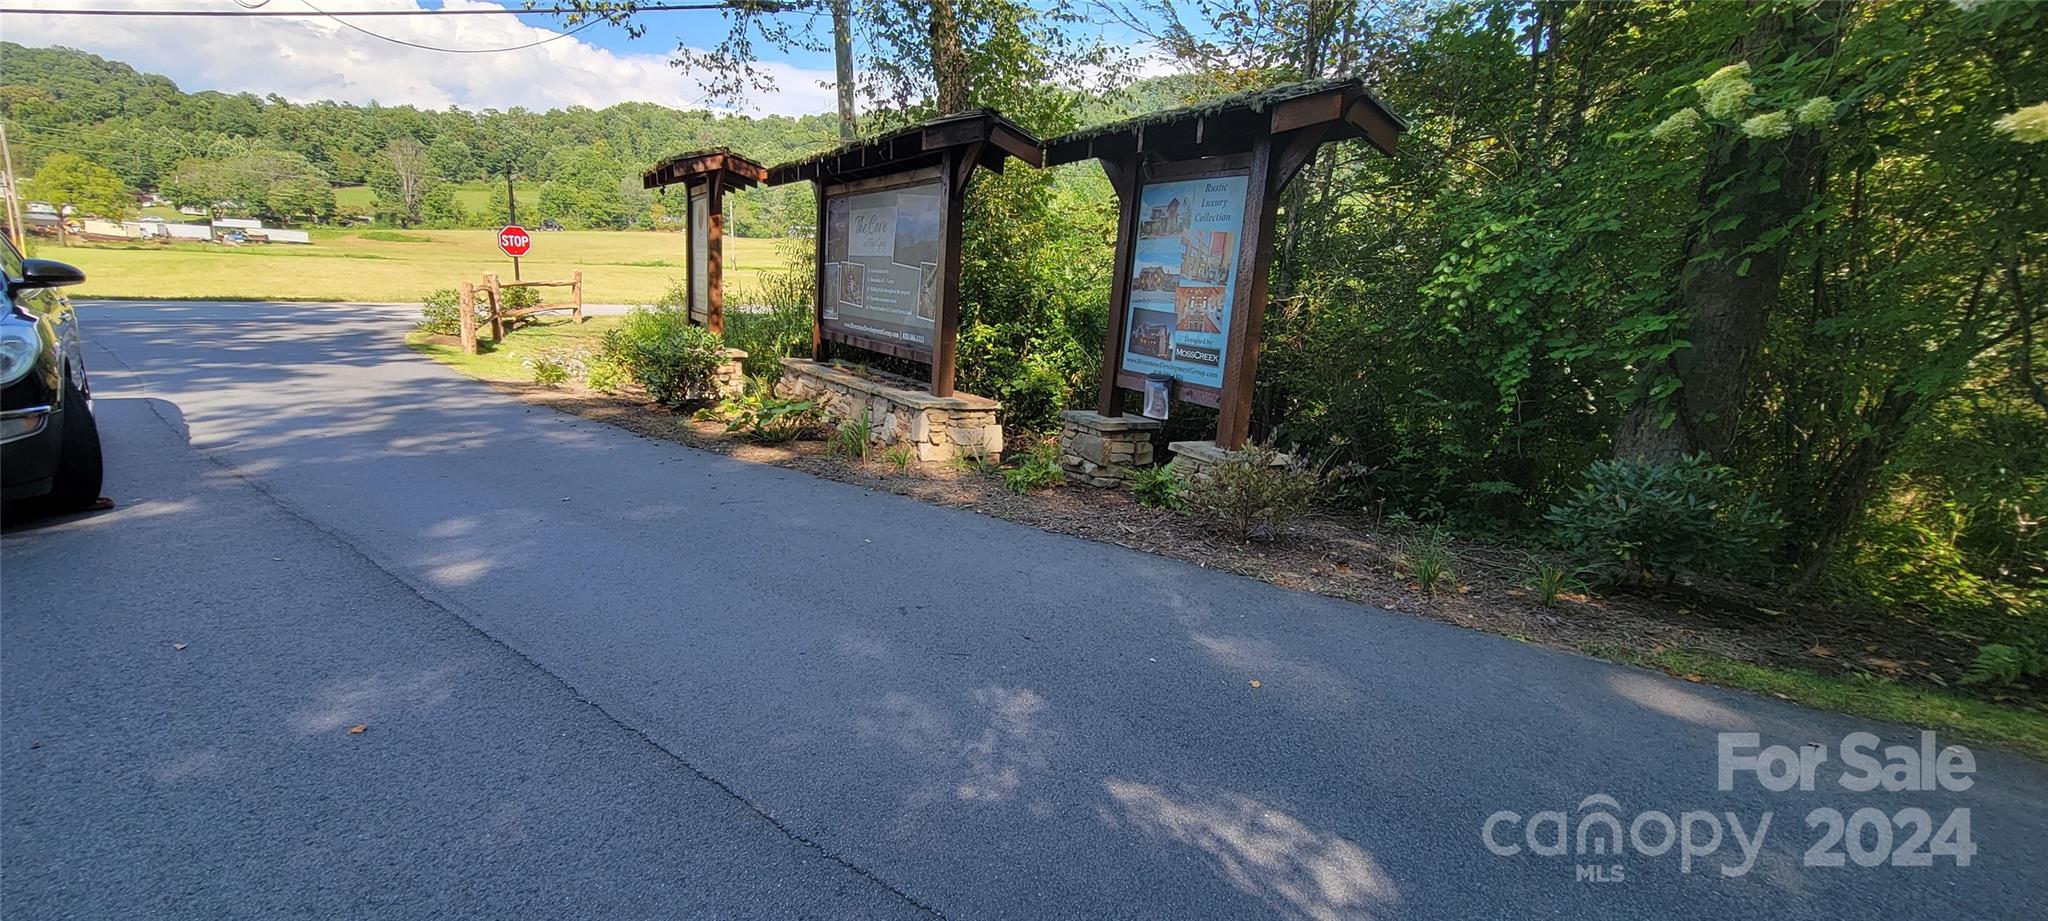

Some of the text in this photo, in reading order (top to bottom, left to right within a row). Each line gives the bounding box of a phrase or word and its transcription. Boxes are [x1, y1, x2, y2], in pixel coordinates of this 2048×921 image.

[1205, 182, 1229, 193] Rustic
[1201, 198, 1228, 209] Luxury
[1194, 212, 1231, 223] Collection
[855, 215, 867, 234] The
[501, 234, 529, 247] STOP
[1184, 335, 1206, 345] Designed
